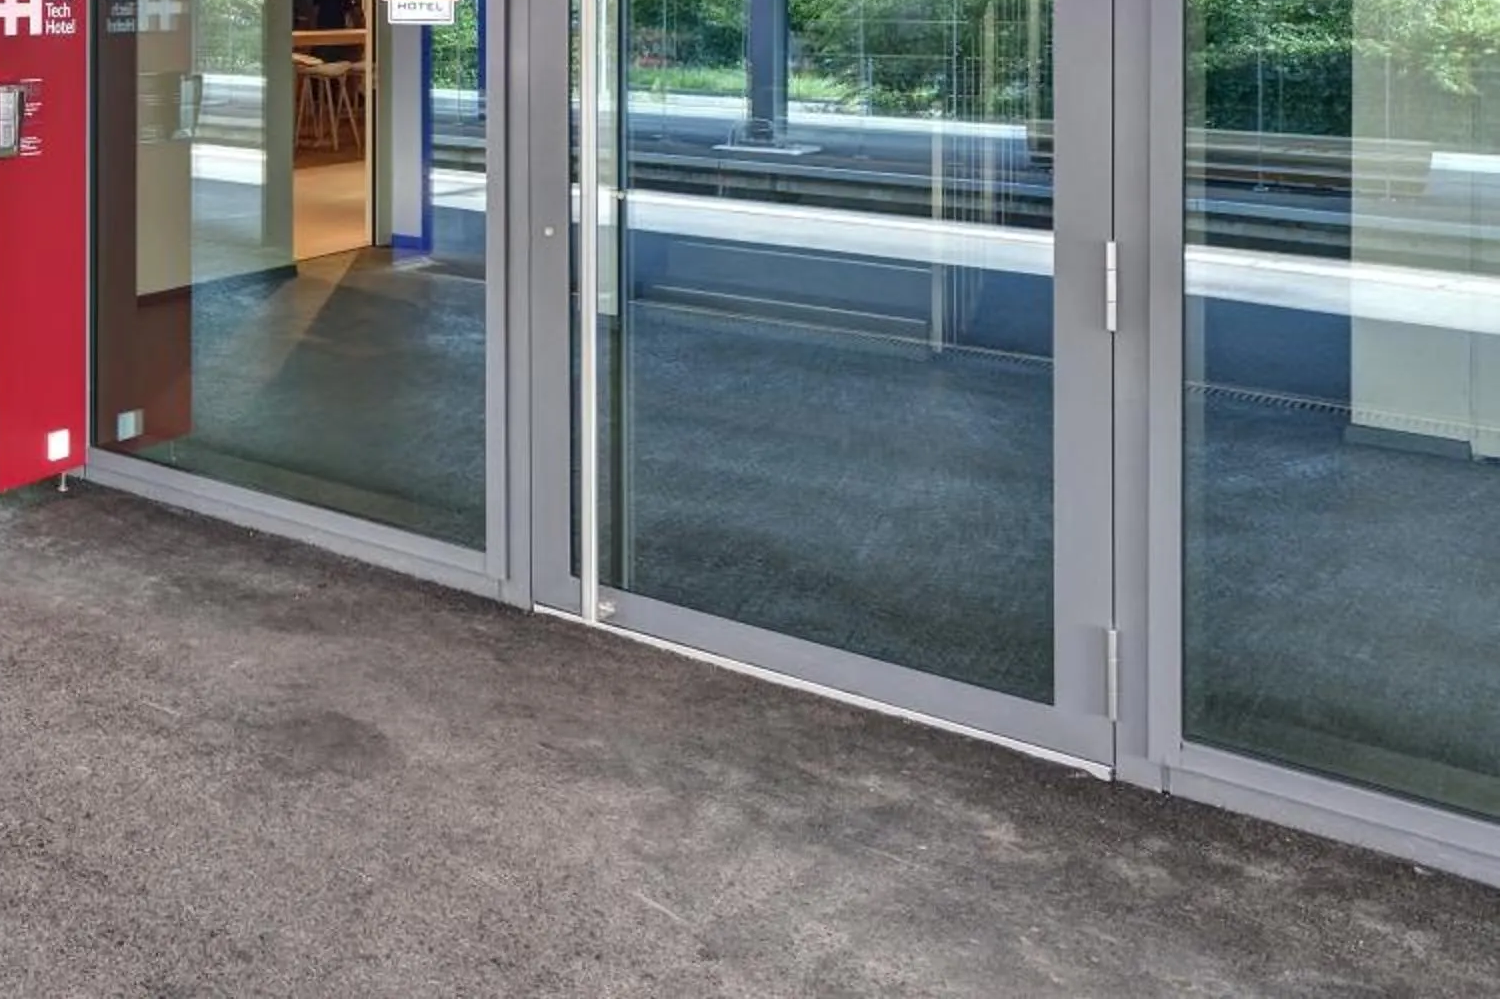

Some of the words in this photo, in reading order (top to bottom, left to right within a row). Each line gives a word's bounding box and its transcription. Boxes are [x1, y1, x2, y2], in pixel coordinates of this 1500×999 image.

[45, 3, 71, 18] Tech
[397, 1, 443, 12] HOTEL
[45, 21, 77, 35] Hotel
